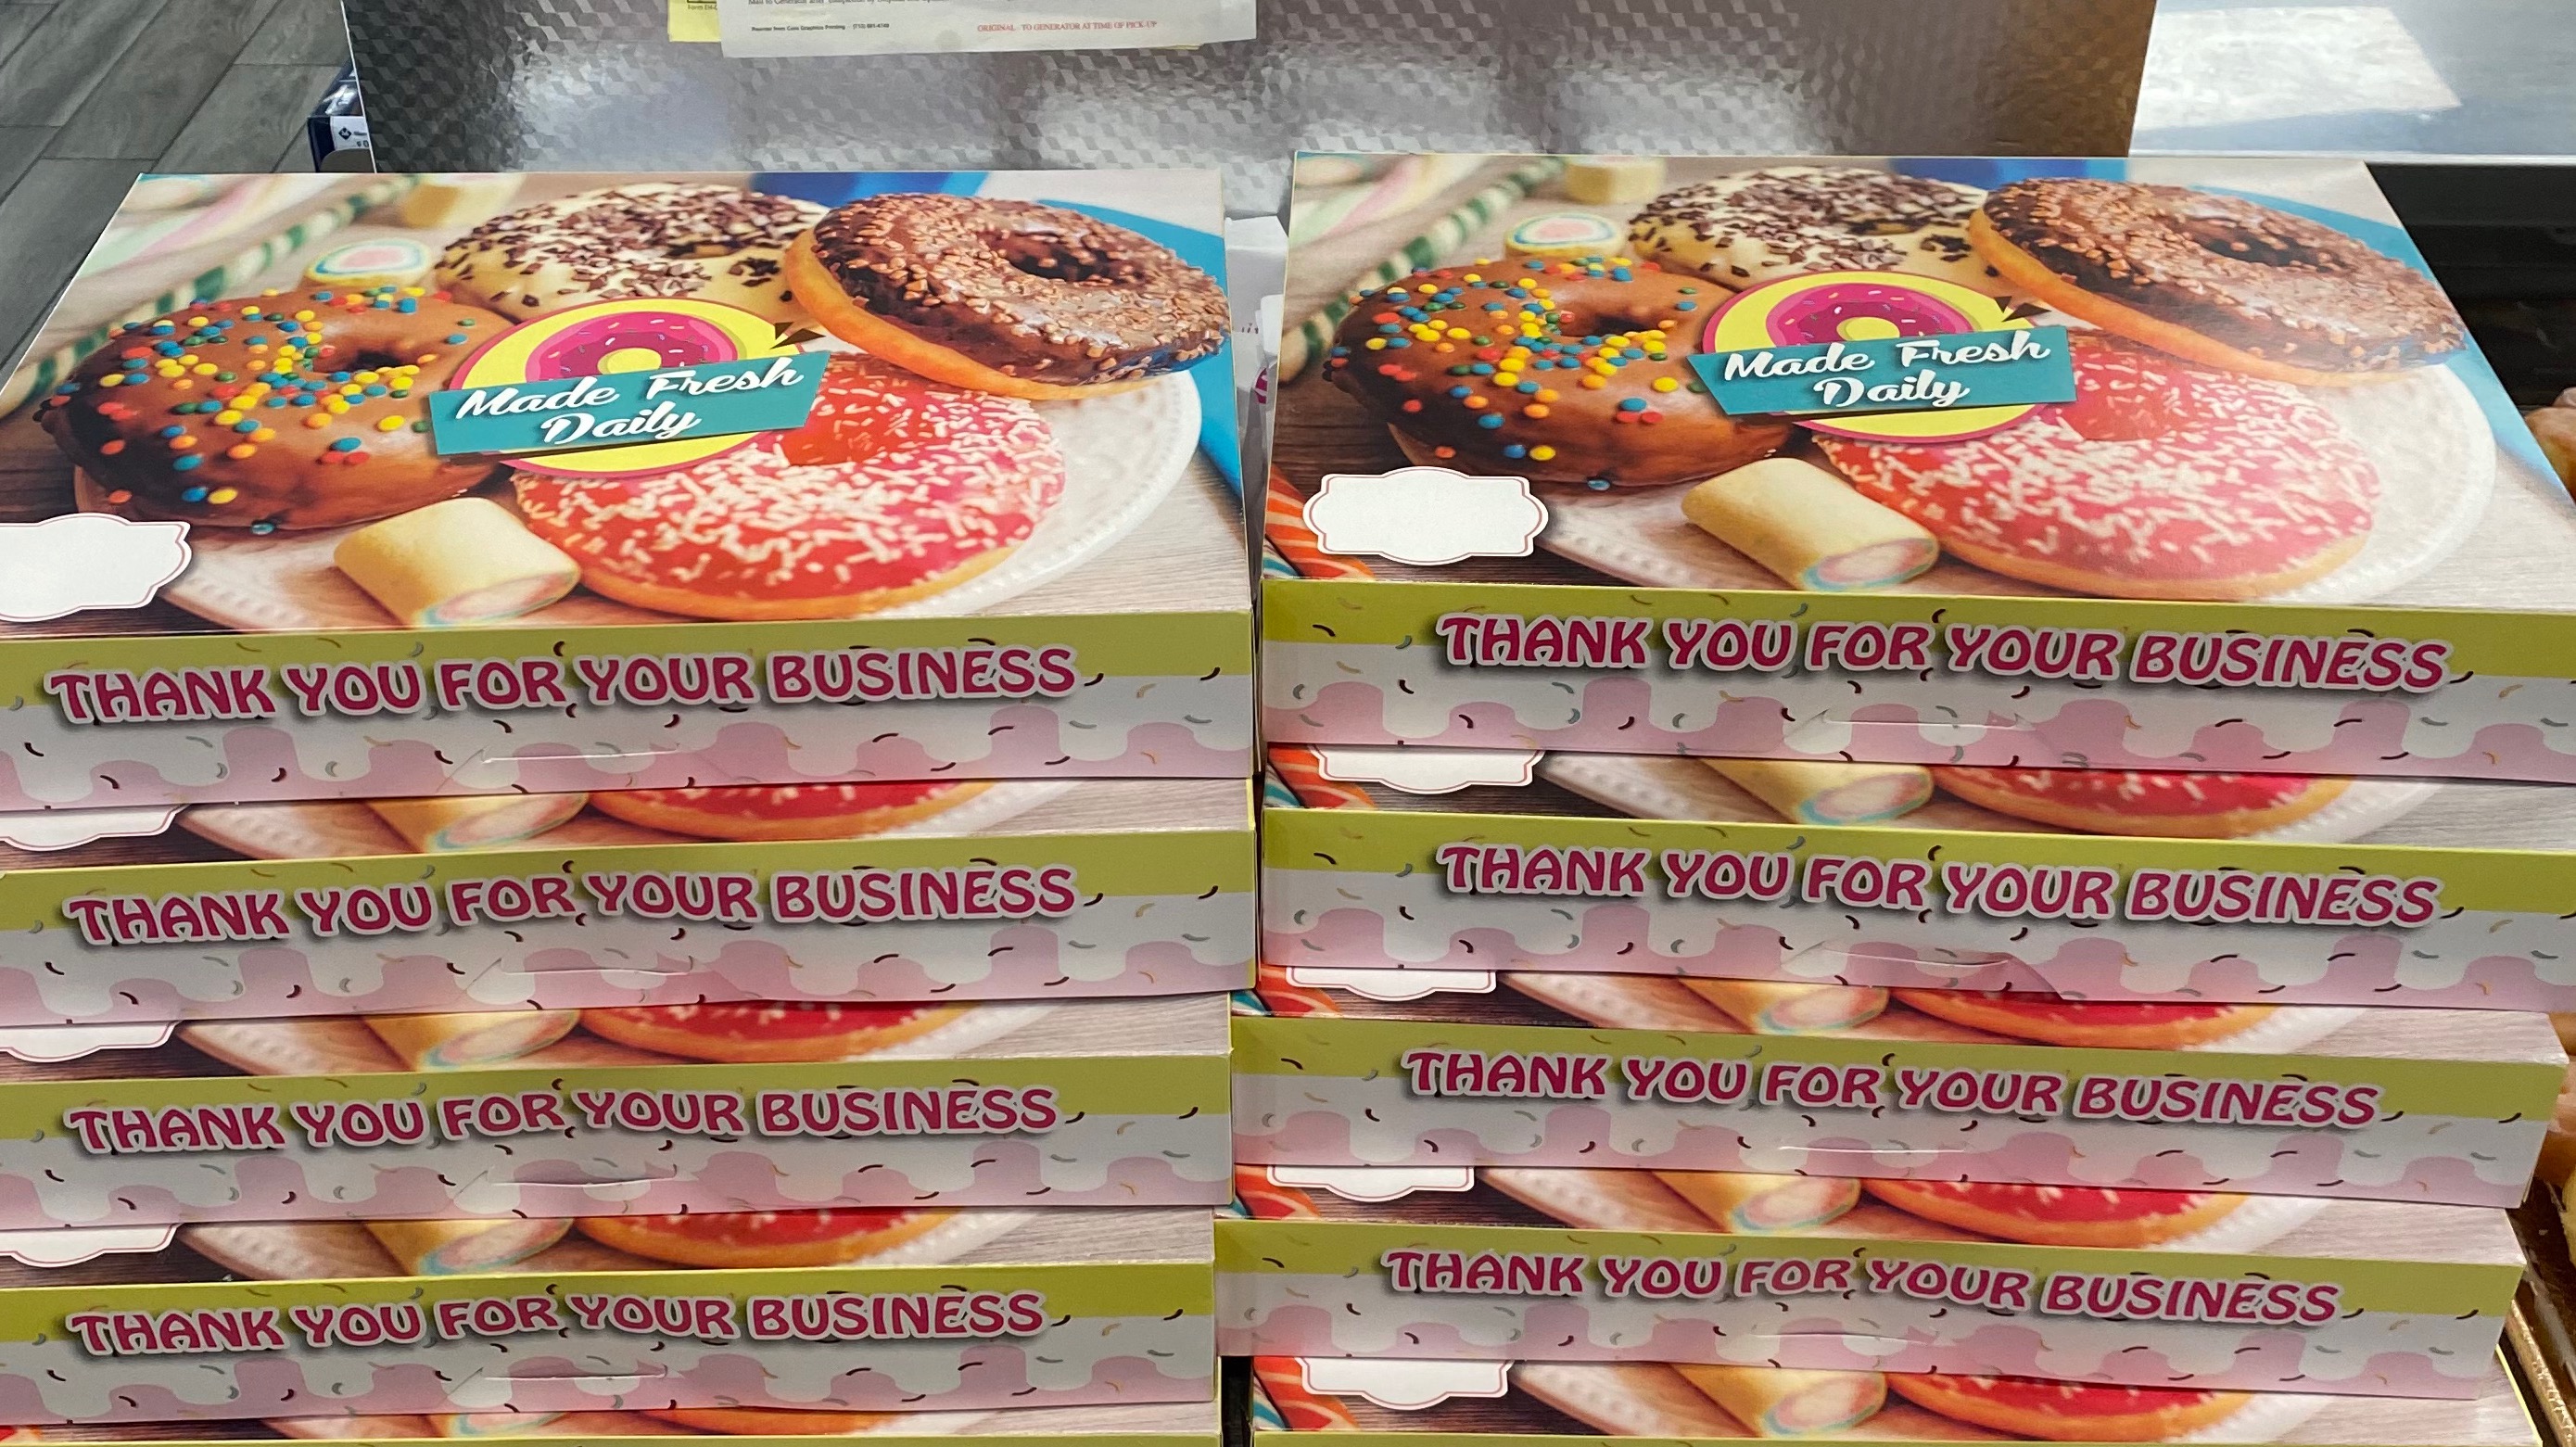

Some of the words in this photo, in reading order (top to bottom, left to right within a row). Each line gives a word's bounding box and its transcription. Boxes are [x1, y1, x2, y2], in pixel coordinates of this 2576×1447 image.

[1034, 22, 1081, 31] GENERATOR
[455, 375, 620, 420] Made
[646, 356, 805, 400] Fresh
[1725, 342, 1875, 381] Made
[1896, 329, 2051, 368] Fresh
[1813, 368, 1971, 408] Daily
[540, 400, 703, 445] Daily
[47, 666, 277, 720] THANK
[285, 663, 423, 713] YOU
[438, 658, 568, 709] FOR
[577, 654, 756, 704] YOUR
[770, 646, 1077, 701] BUSINESS
[1440, 615, 1648, 666] THANK
[1667, 620, 1794, 669] YOU
[1808, 623, 1932, 669] FOR
[1948, 626, 2121, 679] YOUR
[2133, 633, 2449, 691] BUSINESS
[68, 892, 291, 944] THANK
[298, 885, 434, 933] YOU
[450, 875, 577, 924] FOR
[586, 872, 760, 920] YOUR
[774, 866, 1077, 920] BUSINESS
[1440, 844, 1646, 895] THANK
[1664, 851, 1791, 899] YOU
[1805, 856, 1929, 909] FOR
[1945, 863, 2115, 918] YOUR
[2128, 870, 2439, 926] BUSINESS
[68, 1105, 287, 1152] THANK
[295, 1100, 426, 1146] YOU
[440, 1092, 565, 1138] FOR
[576, 1090, 745, 1134] YOUR
[759, 1086, 1059, 1135] BUSINESS
[1406, 1049, 1609, 1097] THANK
[1625, 1057, 1749, 1103] YOU
[1763, 1062, 1883, 1107] FOR
[1898, 1068, 2064, 1115] YOUR
[2076, 1075, 2379, 1128] BUSINESS
[1385, 1249, 1585, 1295] THANK
[1602, 1256, 1724, 1298] YOU
[1738, 1257, 1853, 1296] FOR
[1869, 1258, 2032, 1310] YOUR
[2044, 1273, 2340, 1325] BUSINESS
[70, 1309, 286, 1353] THANK
[292, 1304, 423, 1346] YOU
[437, 1297, 559, 1339] FOR
[569, 1295, 736, 1338] YOUR
[750, 1291, 1045, 1339] BUSINESS
